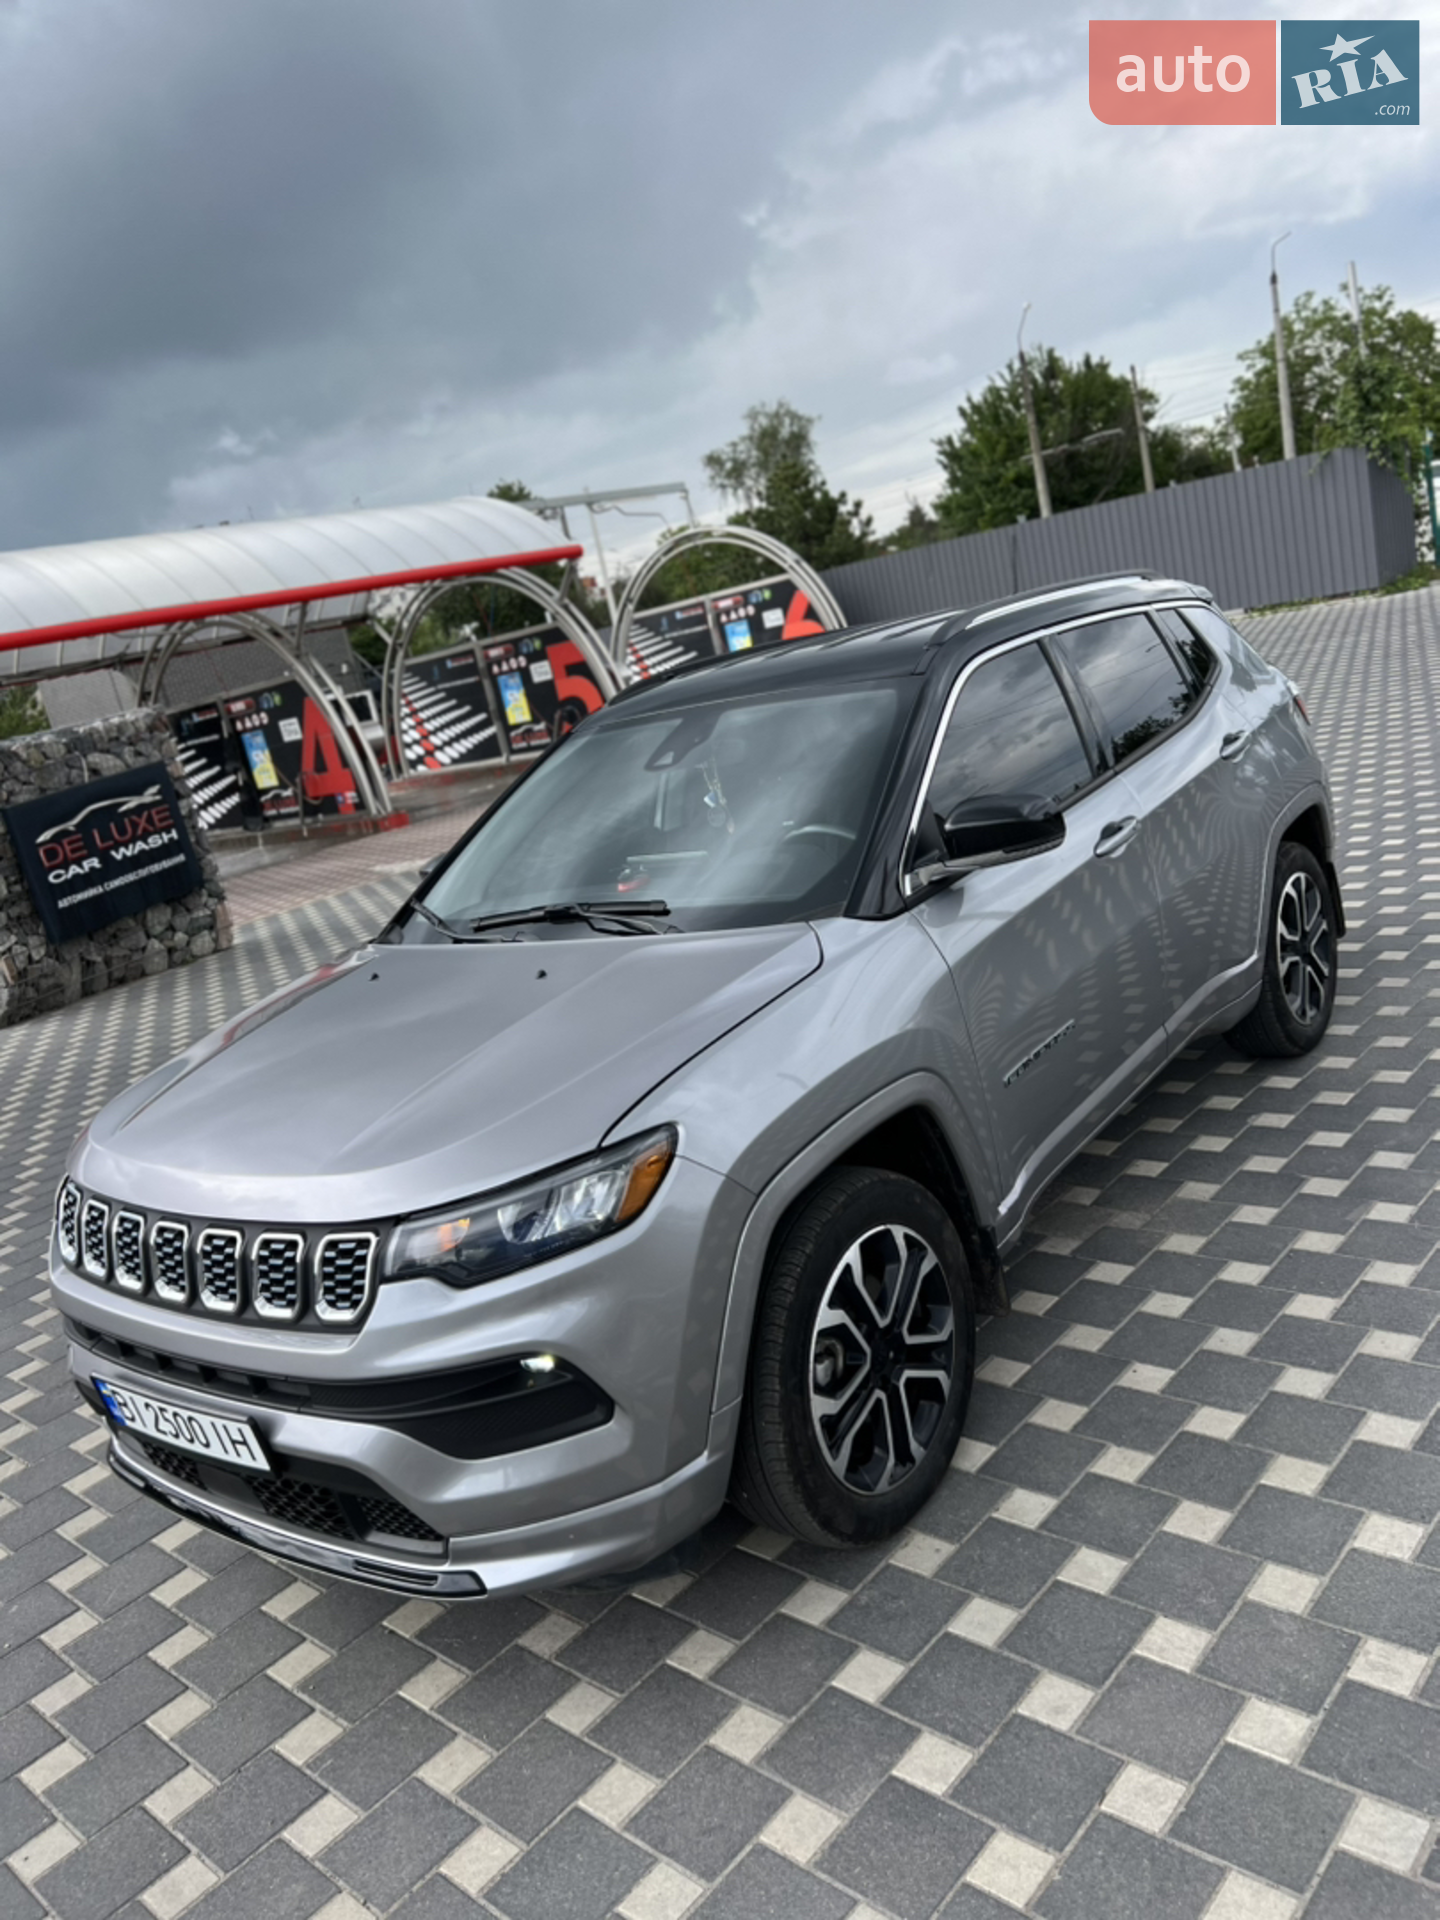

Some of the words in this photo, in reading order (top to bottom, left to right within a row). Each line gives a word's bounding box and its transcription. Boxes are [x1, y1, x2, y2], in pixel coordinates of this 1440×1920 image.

[545, 638, 606, 734] 5
[302, 697, 356, 815] 4
[38, 834, 88, 868] DE
[93, 804, 174, 849] LUXE
[48, 857, 102, 884] CAR
[110, 828, 179, 861] WASH
[144, 1402, 211, 1449] 2500
[210, 1420, 257, 1462] IH
